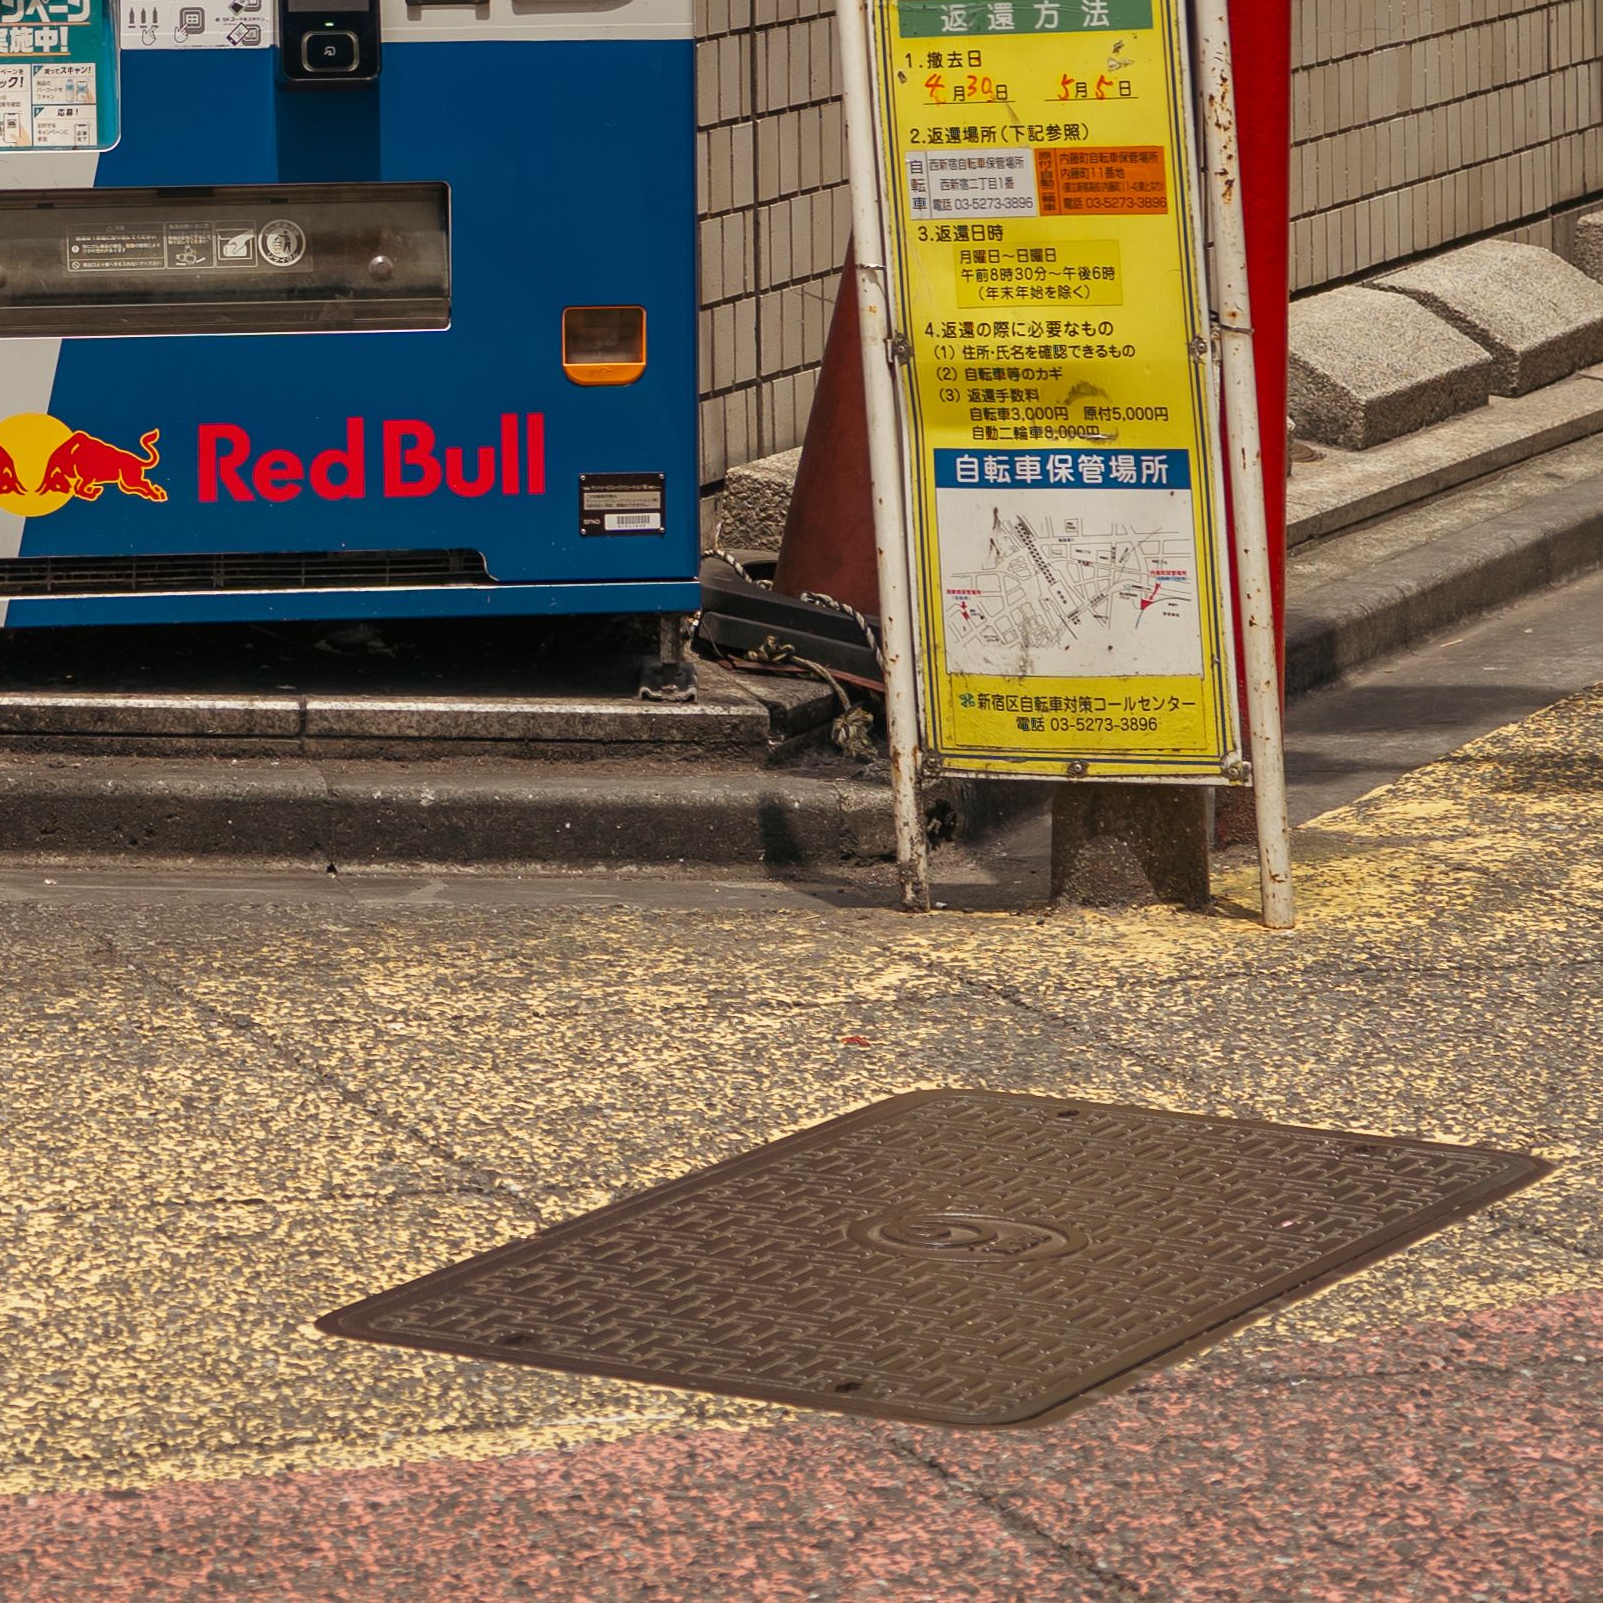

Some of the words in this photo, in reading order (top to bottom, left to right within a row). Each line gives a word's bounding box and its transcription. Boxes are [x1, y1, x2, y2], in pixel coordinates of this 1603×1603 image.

[929, 156, 1025, 172] 西新宿自転車保管場所
[909, 160, 928, 211] 自転車
[940, 177, 1015, 192] 西新宿二丁目1番
[932, 198, 952, 212] 電話
[954, 197, 1034, 211] 03-5273-3896
[1063, 198, 1082, 211] 電話
[1085, 196, 1168, 210] 03-5273-3896
[918, 225, 1004, 243] 3.返還日時
[978, 284, 1092, 302] （年末年始を除く）
[925, 320, 1114, 339] 4.返還の際に必要なもの
[962, 344, 1136, 361] 住所・氏名を確認できるもの
[964, 366, 1063, 382] 自転車等のカギ
[967, 388, 1040, 403] 返還手数料
[970, 406, 1069, 422] 自転車3,000円
[1083, 406, 1169, 422] 原付5,000円
[972, 425, 1100, 441] 自動二輪車8,000円
[198, 417, 365, 502] Red
[383, 413, 546, 498] Bull
[955, 454, 1170, 485] 自転車保管場所
[977, 693, 1196, 714] 新宿区自転車対策コールセンター
[1015, 716, 1044, 732] 電話
[1050, 717, 1158, 732] 03-5273-3896
